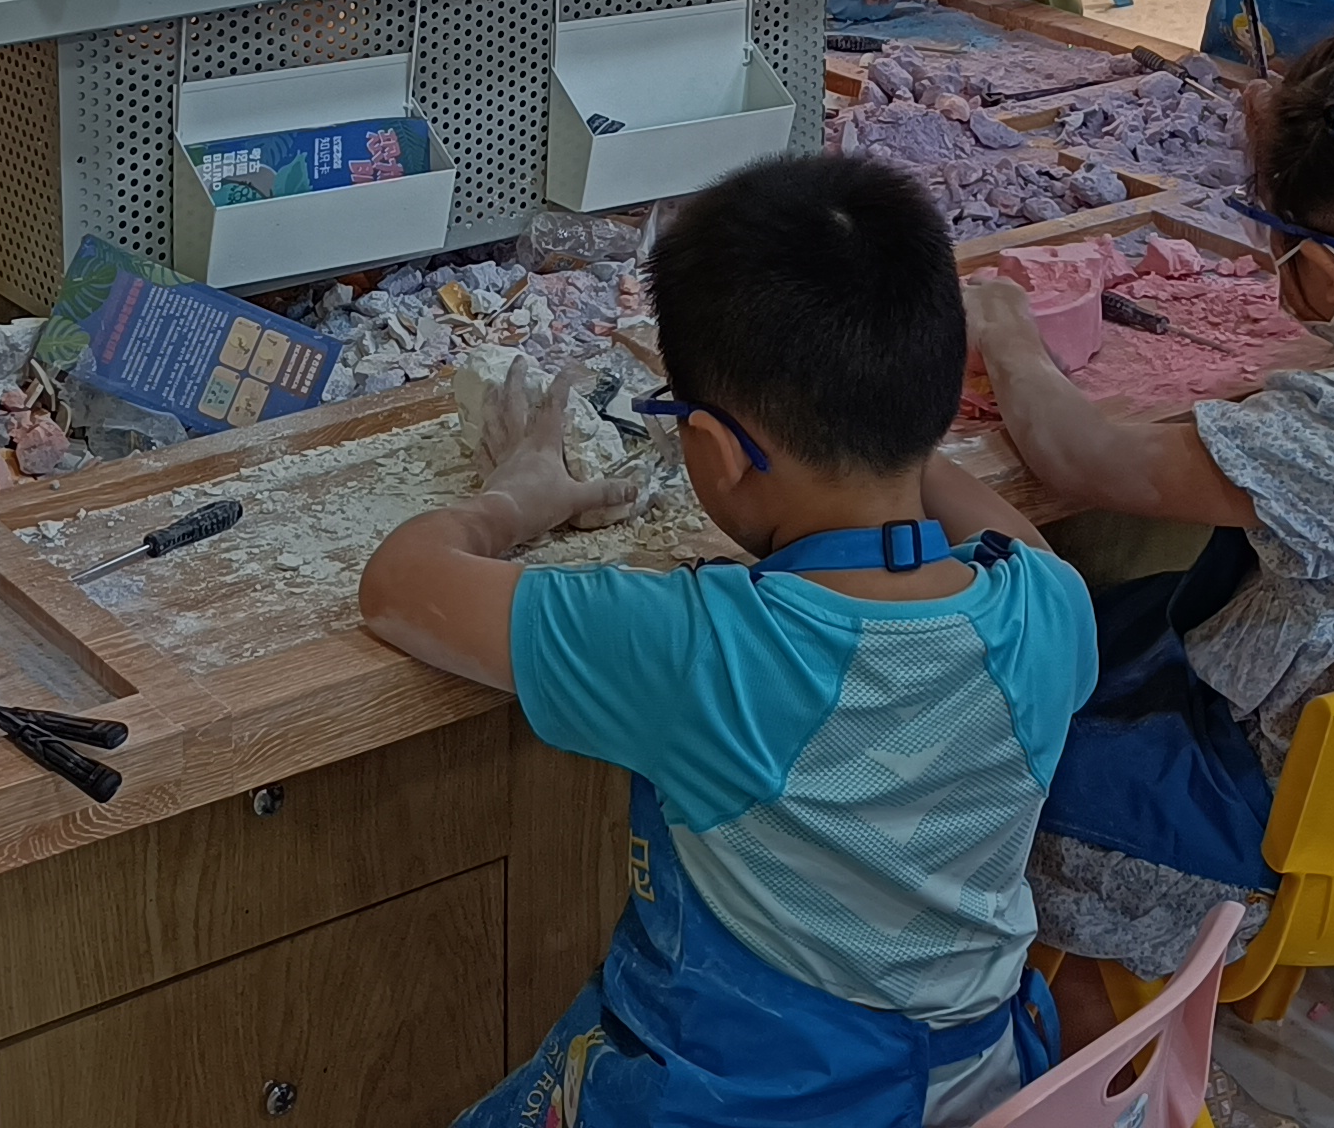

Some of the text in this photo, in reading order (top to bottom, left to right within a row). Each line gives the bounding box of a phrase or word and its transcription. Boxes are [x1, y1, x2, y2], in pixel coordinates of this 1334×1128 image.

[202, 155, 212, 183] BOX
[212, 153, 222, 191] BLIND
[319, 137, 331, 175] 知识卡
